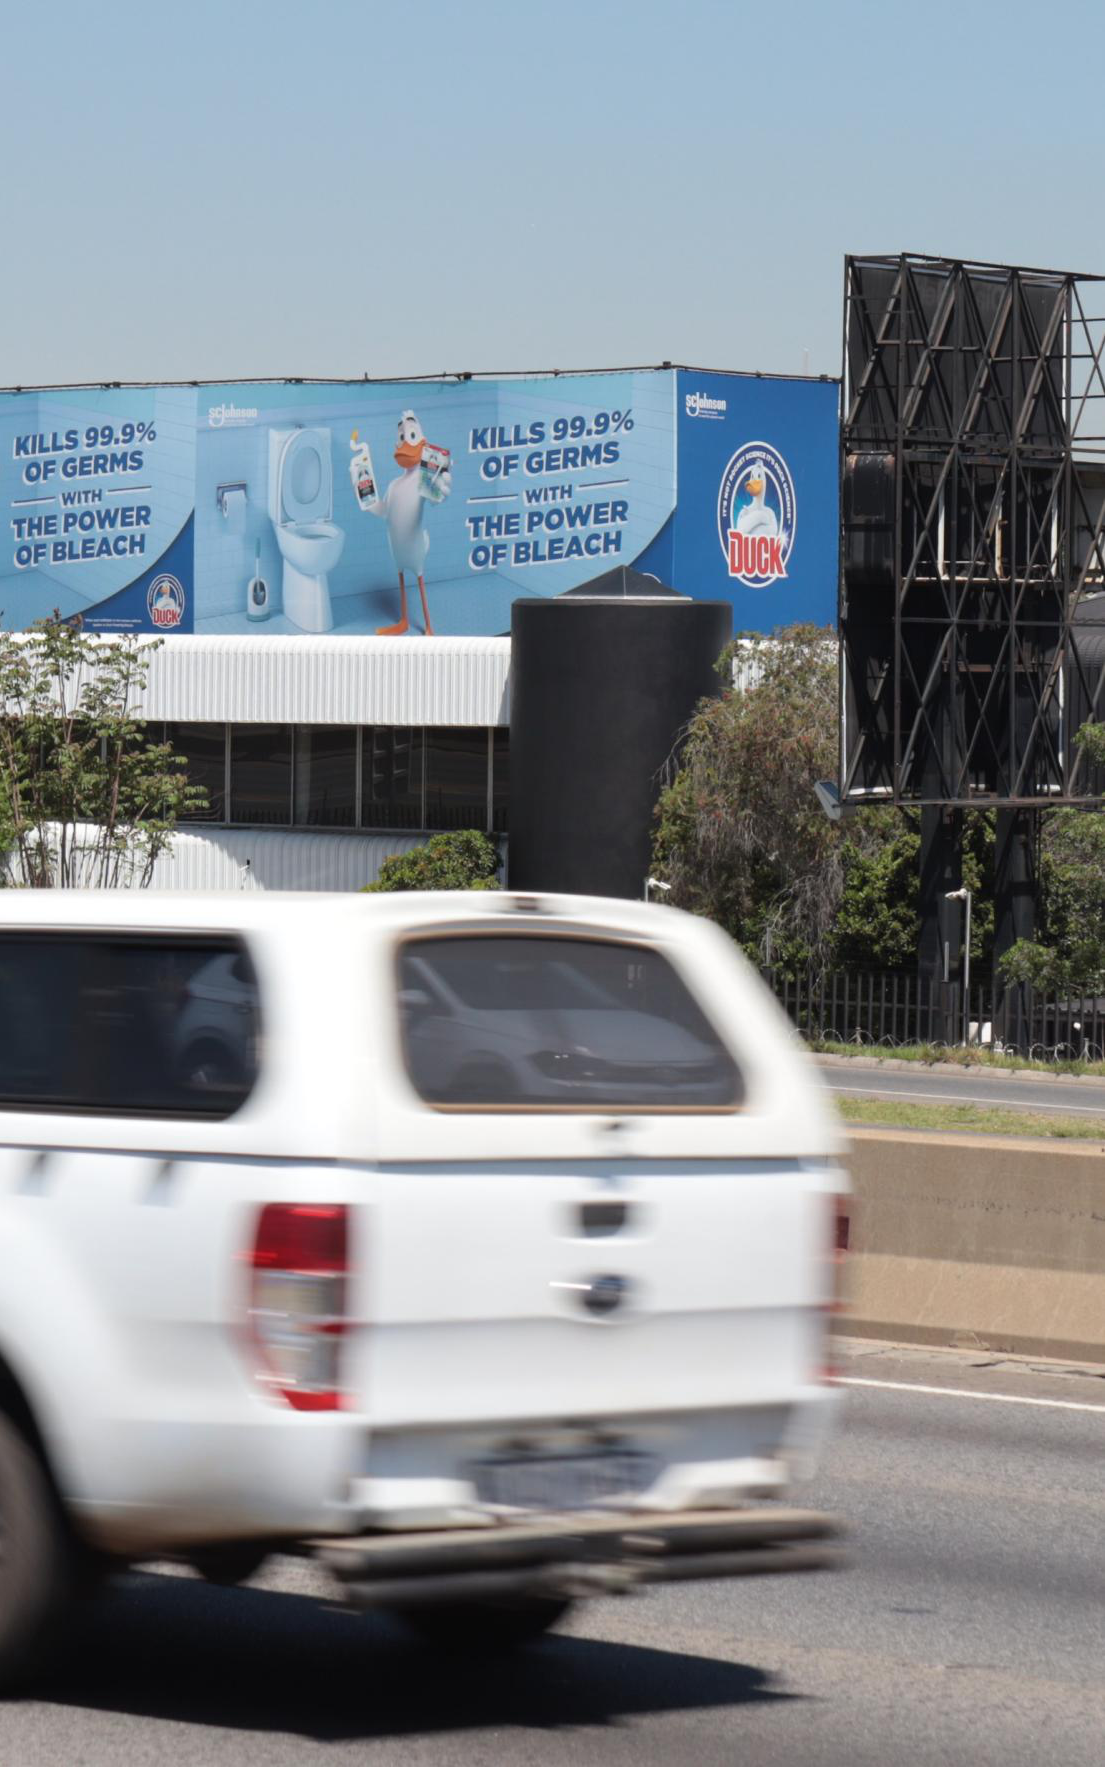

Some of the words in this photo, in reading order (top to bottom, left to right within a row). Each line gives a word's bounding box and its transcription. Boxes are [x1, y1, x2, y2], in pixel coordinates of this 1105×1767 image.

[14, 429, 79, 457] KILLS
[84, 421, 157, 448] 99.9%
[470, 421, 546, 450] KILLS
[552, 409, 635, 441] 99.9%
[24, 459, 57, 483] OF
[61, 450, 144, 478] GERMS
[482, 454, 520, 478] OF
[525, 441, 620, 474] GERMS
[61, 489, 103, 506] WITH
[525, 484, 573, 504] WITH
[12, 514, 58, 538] THE
[62, 505, 152, 534] POWER
[468, 513, 521, 538] THE
[526, 500, 629, 533] POWER
[15, 543, 47, 566] OF
[51, 533, 146, 562] BLEACH
[471, 543, 508, 567] OF
[513, 530, 622, 563] BLEACH
[728, 530, 786, 576] DUCK
[152, 607, 180, 625] DUCK
